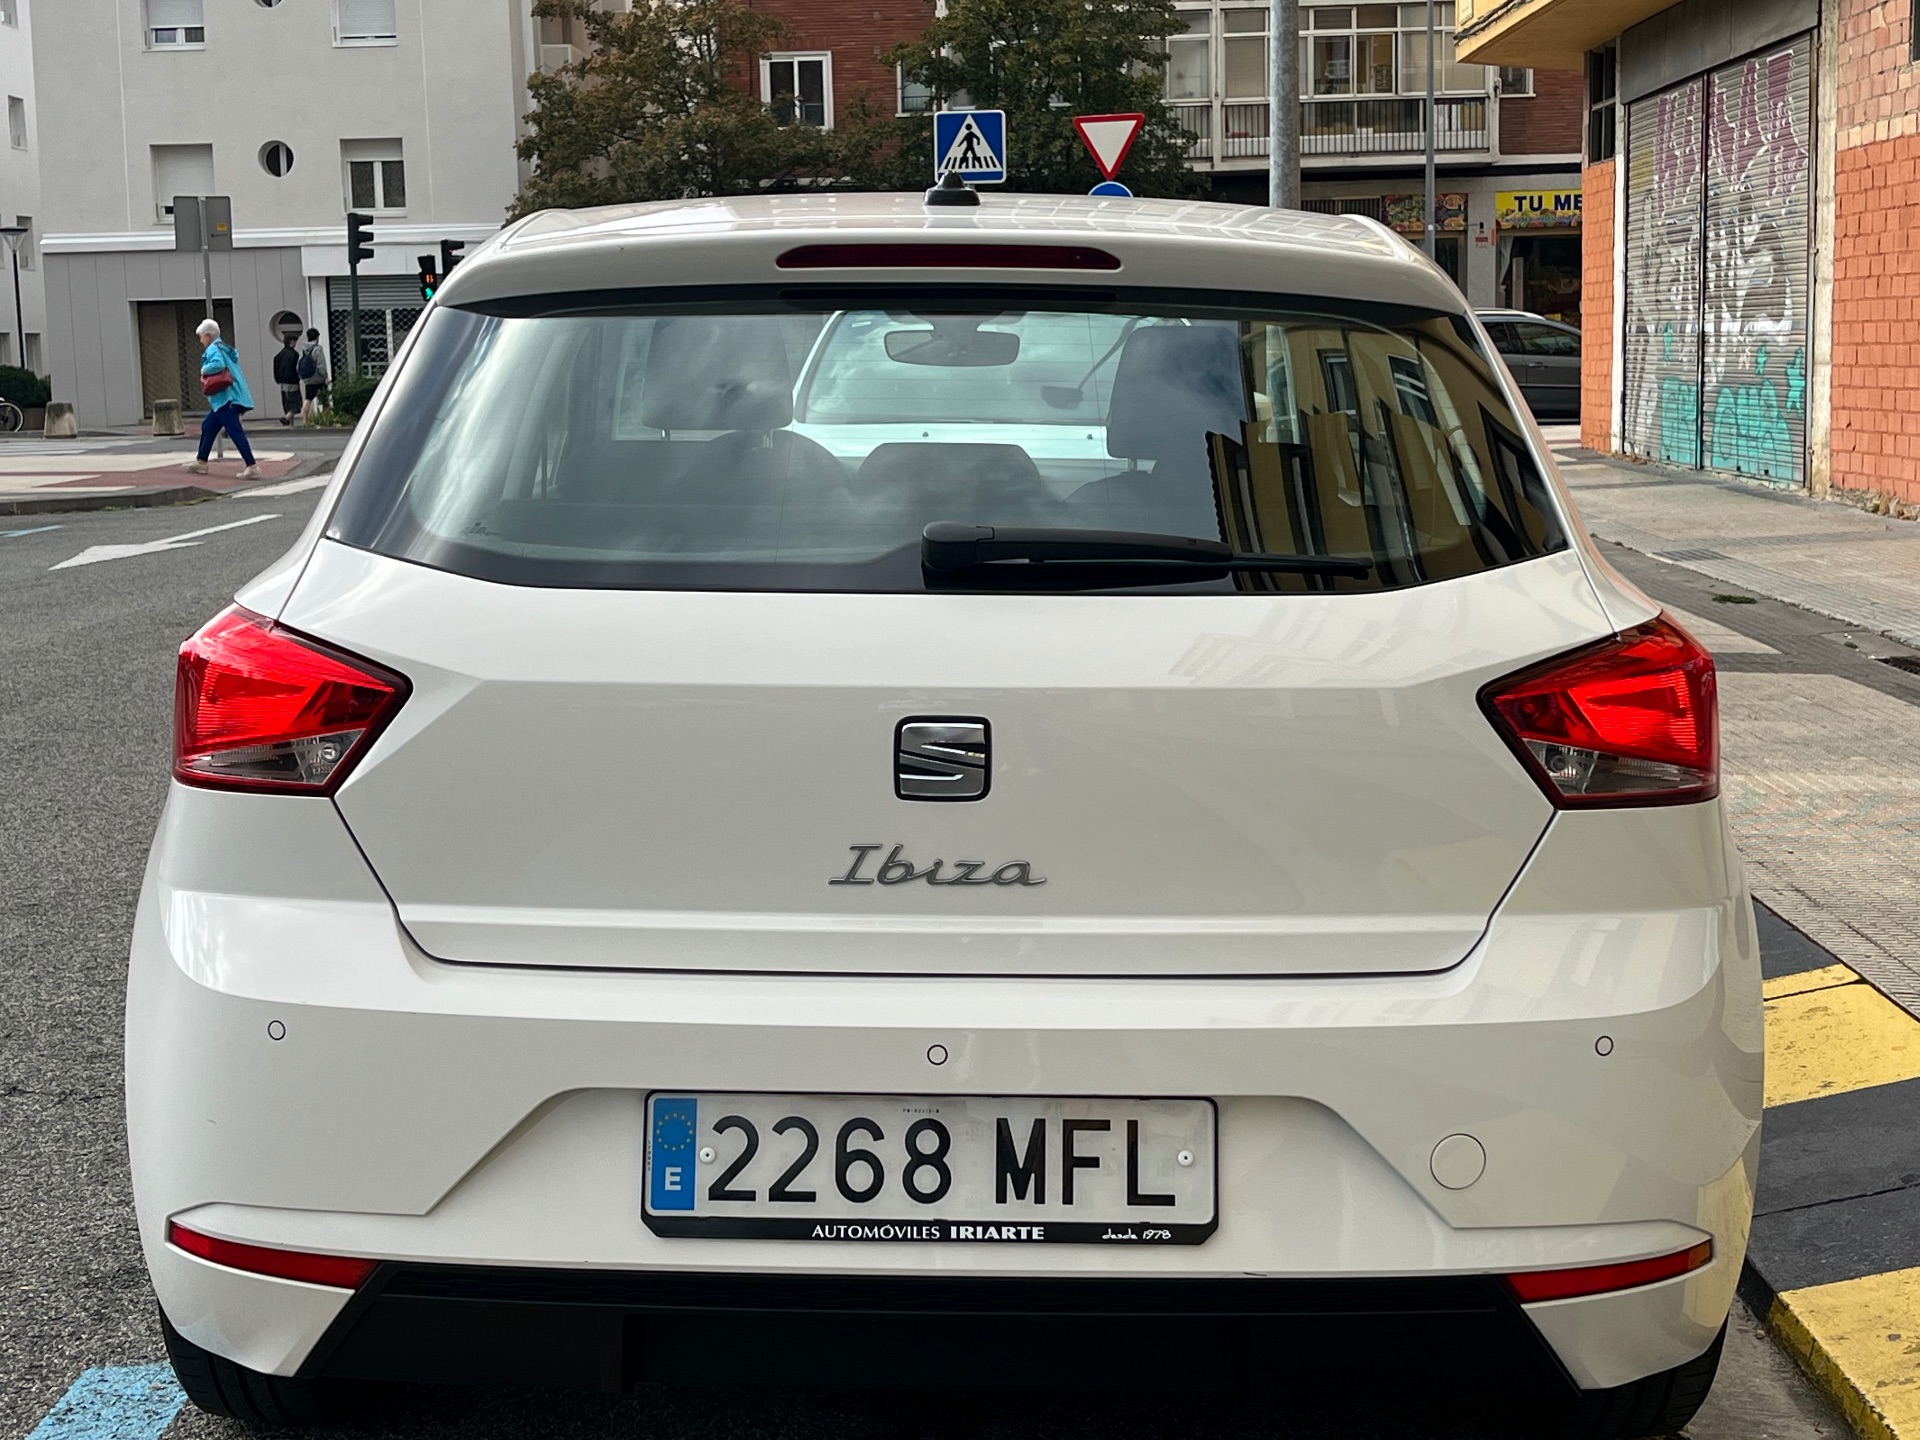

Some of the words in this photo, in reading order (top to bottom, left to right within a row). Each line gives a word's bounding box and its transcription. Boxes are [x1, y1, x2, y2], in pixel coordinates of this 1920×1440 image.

[1513, 195, 1543, 212] TU
[1554, 194, 1582, 210] ME
[828, 843, 1048, 886] Ibiza
[707, 1115, 952, 1205] 2268
[995, 1117, 1177, 1207] MFL
[664, 1166, 682, 1191] E
[811, 1224, 940, 1239] AUTOMÓVILES
[950, 1225, 1045, 1240] IRIARTE
[1101, 1227, 1138, 1240] desde
[1142, 1229, 1172, 1240] 1978
